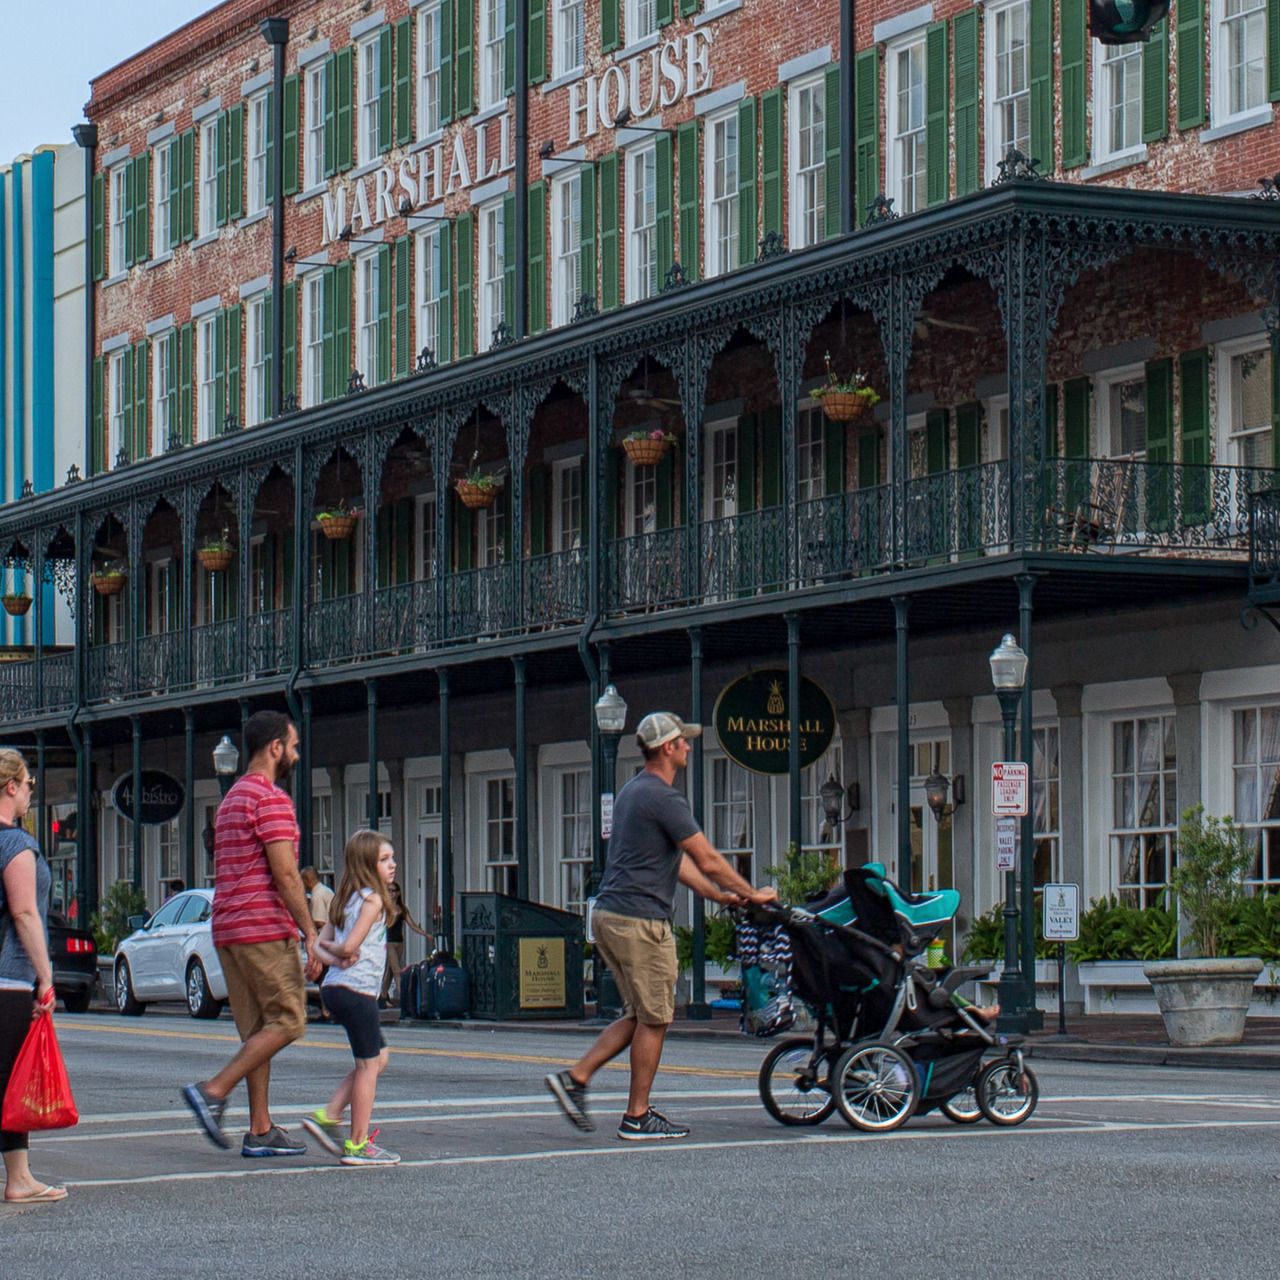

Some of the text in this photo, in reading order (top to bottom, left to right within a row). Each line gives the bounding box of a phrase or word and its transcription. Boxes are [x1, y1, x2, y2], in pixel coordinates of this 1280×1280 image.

[322, 28, 713, 247] MARSHALL HOUSE
[746, 735, 807, 752] HOUE
[993, 766, 1003, 778] NO
